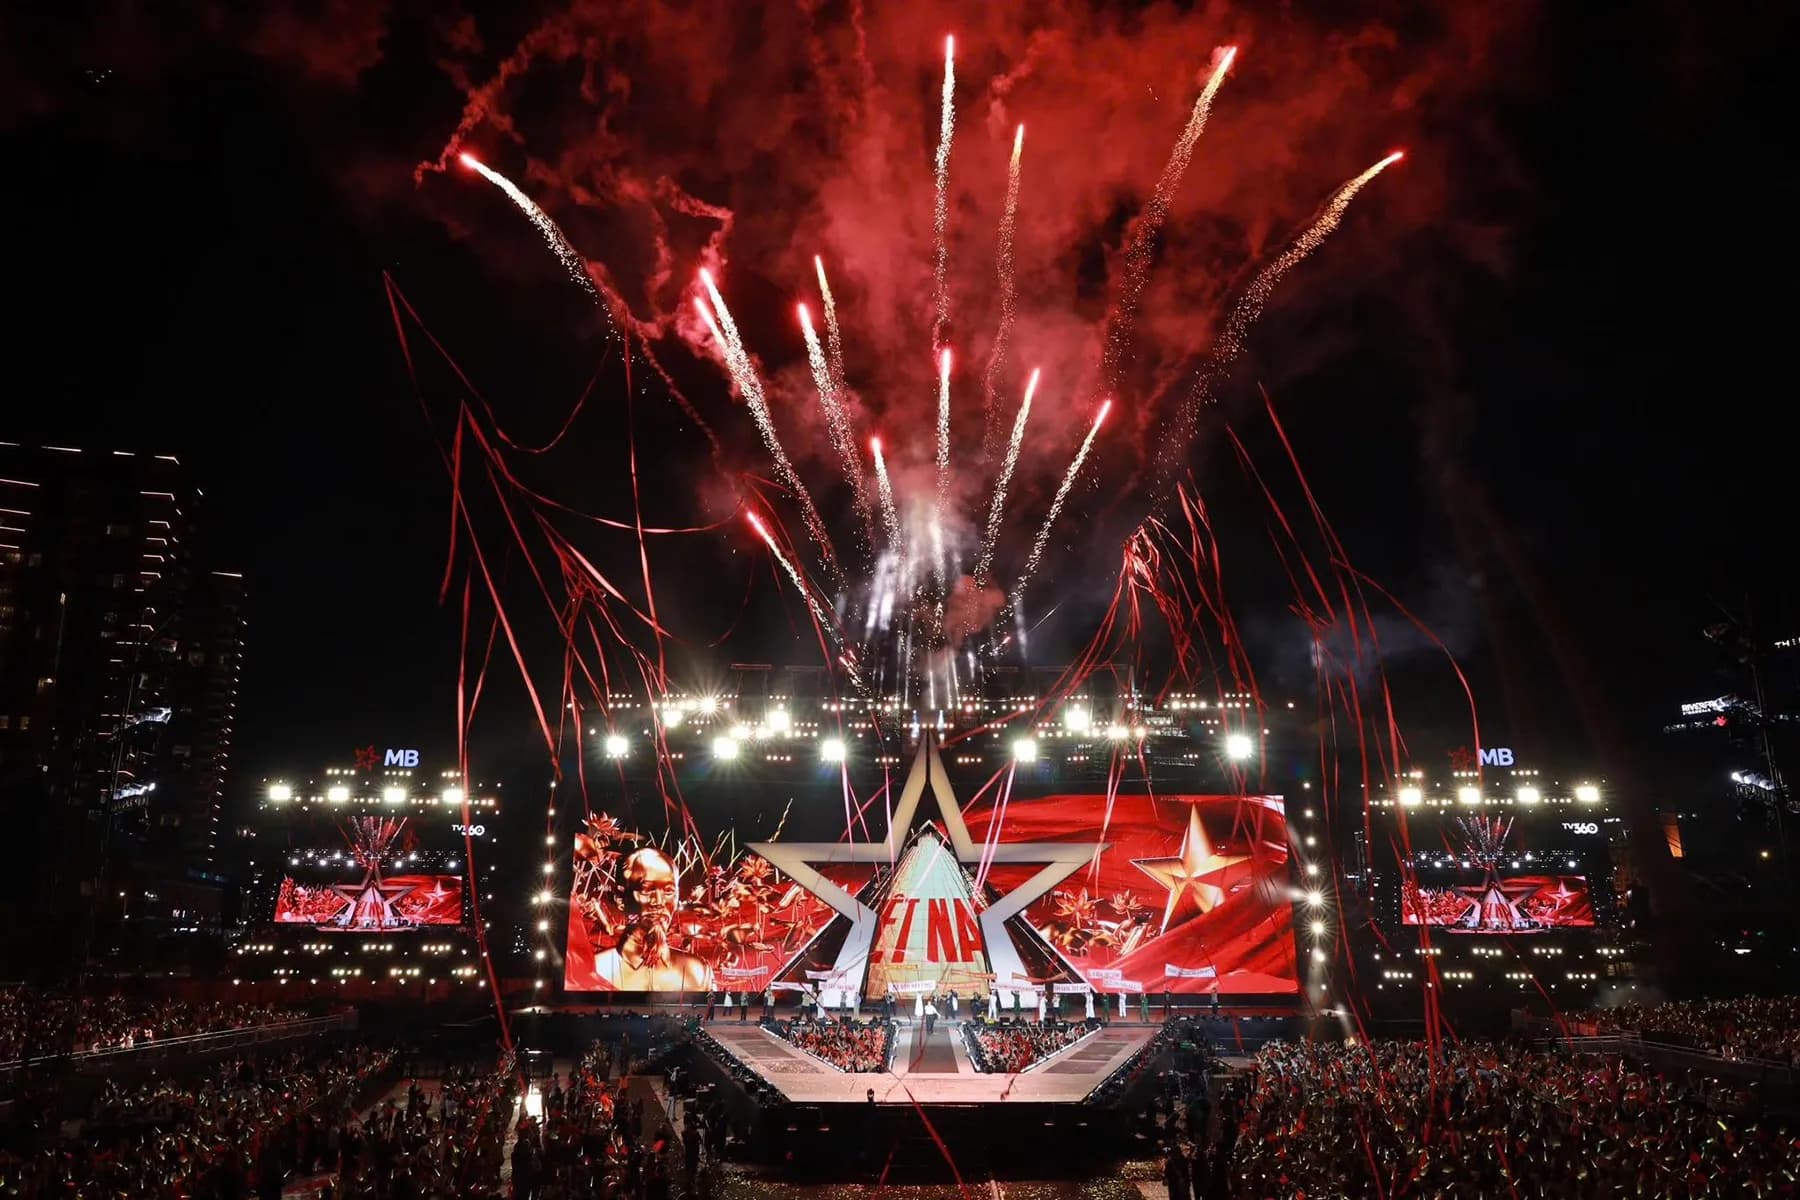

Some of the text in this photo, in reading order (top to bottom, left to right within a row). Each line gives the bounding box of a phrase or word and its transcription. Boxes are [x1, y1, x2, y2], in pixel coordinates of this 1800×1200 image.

[384, 748, 419, 767] MB
[1478, 748, 1514, 766] MB
[1561, 822, 1598, 834] TV360
[927, 898, 985, 963] NA
